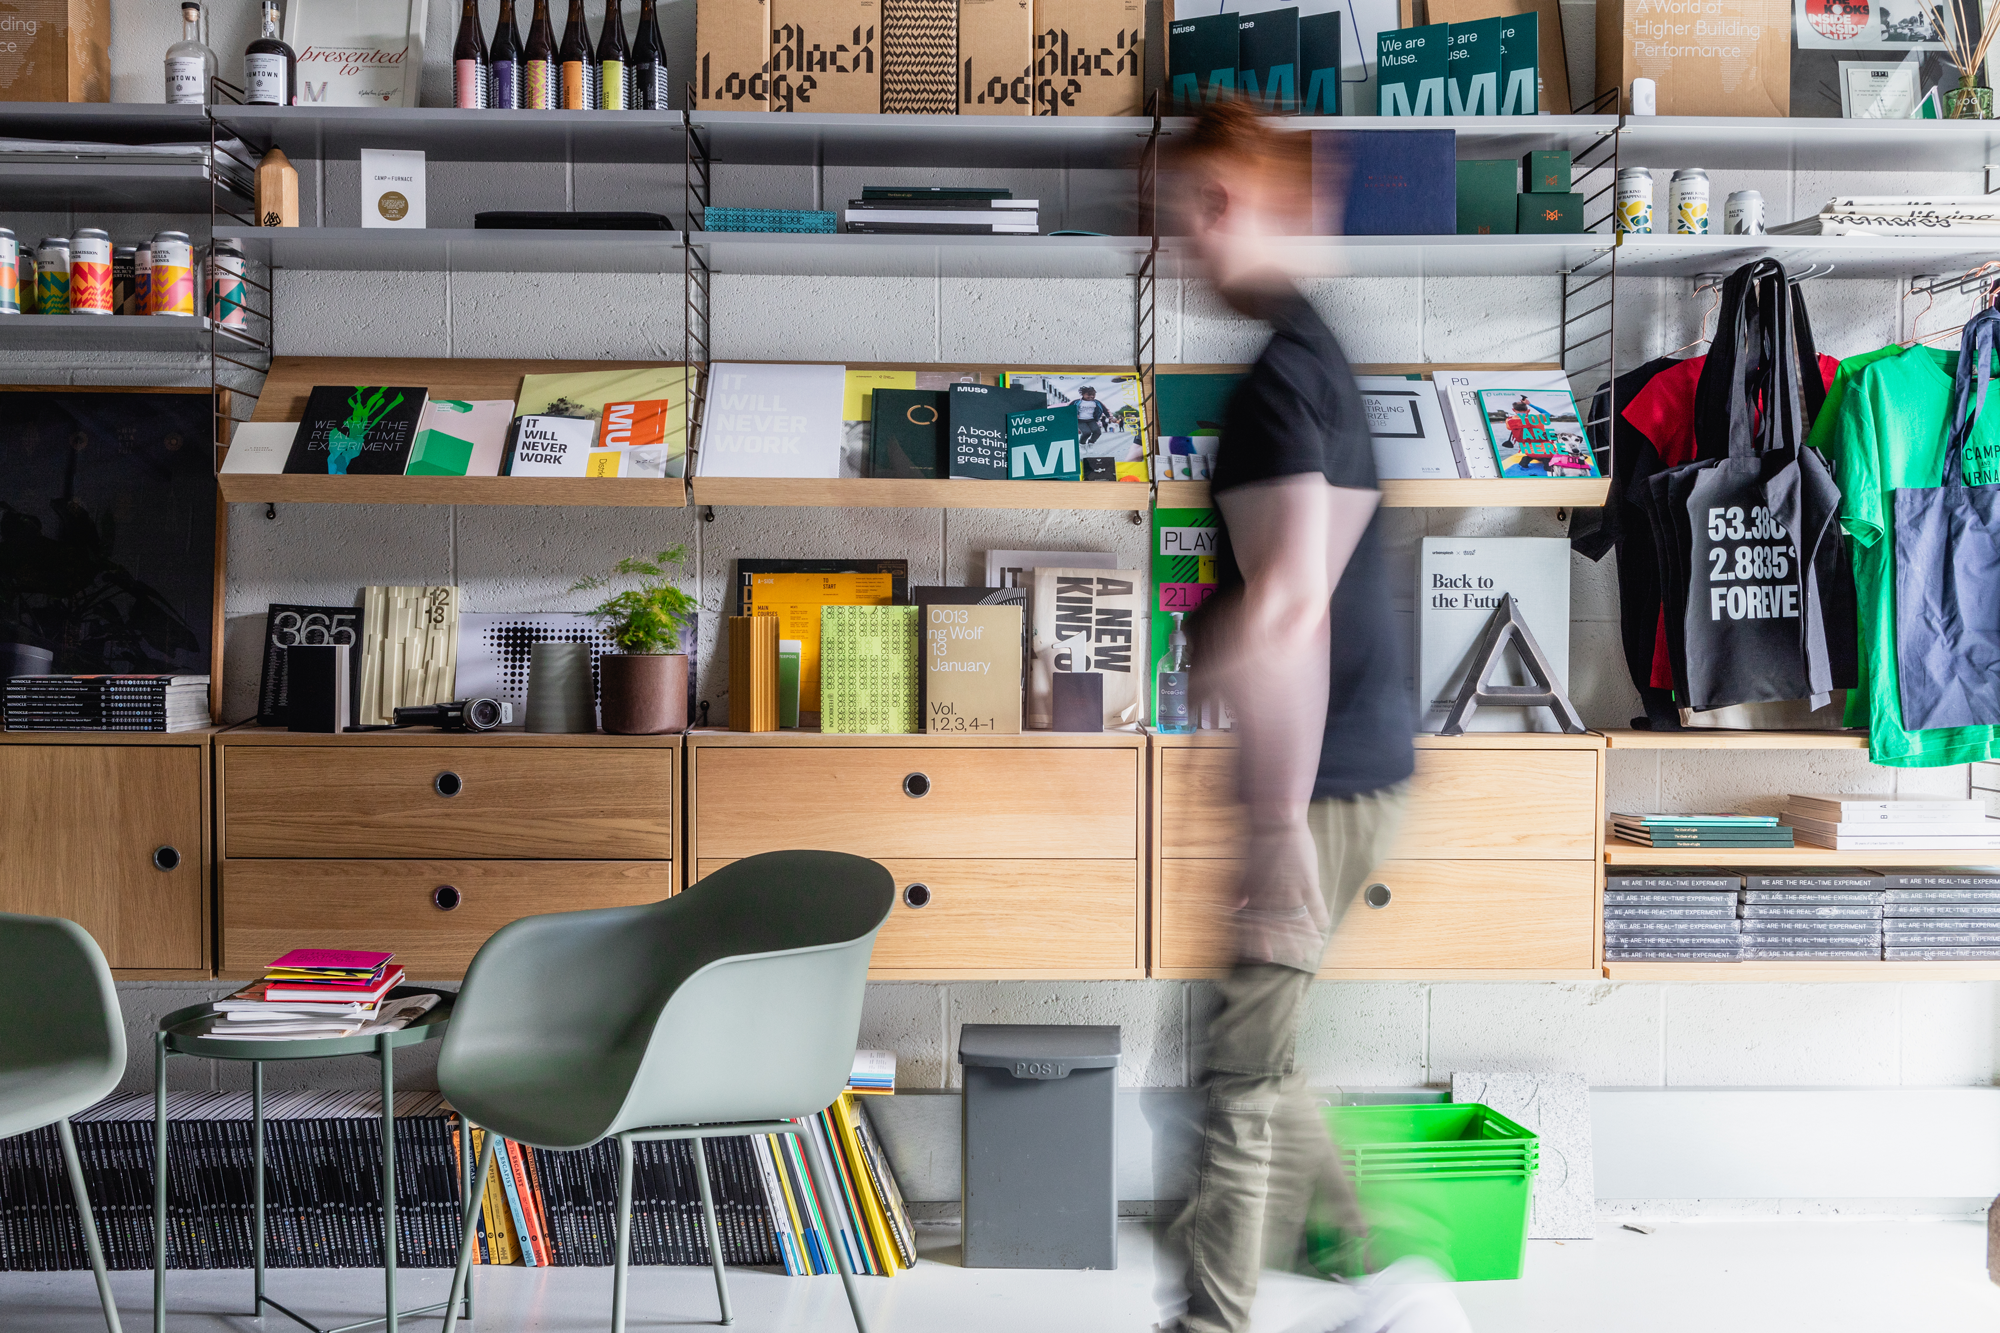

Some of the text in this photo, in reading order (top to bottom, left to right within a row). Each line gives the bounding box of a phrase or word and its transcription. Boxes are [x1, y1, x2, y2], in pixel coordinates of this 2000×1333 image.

[1636, 0, 1724, 13] A World of
[1240, 21, 1254, 30] use
[1635, 20, 1761, 40] Higher Building
[1381, 37, 1425, 52] We are
[1457, 32, 1477, 44] are
[297, 46, 408, 64] presented
[773, 23, 874, 73] Black
[1038, 28, 1138, 76] Black
[1635, 41, 1741, 57] Performance
[1381, 54, 1418, 67] Muse.
[339, 63, 364, 76] to
[721, 373, 747, 391] IT
[719, 393, 788, 412] WILL
[1120, 376, 1139, 436] PORT LOOP
[315, 420, 409, 430] WE ARE THE
[526, 418, 540, 428] IT
[716, 413, 808, 434] NEVER
[1011, 414, 1055, 426] We are
[1517, 413, 1551, 426] YOU
[524, 429, 558, 441] WILL
[957, 425, 1002, 438] A book
[1011, 425, 1048, 436] Muse.
[1522, 428, 1558, 441] ARE
[307, 441, 403, 451] EXPERIMENT
[714, 434, 801, 455] WORK
[957, 435, 979, 444] the
[521, 441, 568, 454] NEVER
[957, 444, 991, 456] do to
[1520, 442, 1569, 455] HERE
[519, 452, 563, 465] WORK
[957, 454, 990, 466] great
[1011, 439, 1077, 478] M
[1962, 470, 2000, 486] URNA
[1165, 531, 1217, 551] PLAY
[1432, 573, 1494, 588] Back to
[429, 588, 450, 606] 12
[1432, 593, 1519, 608] the Futue
[1710, 584, 1799, 621] FOREVE
[425, 606, 445, 623] 13
[931, 610, 968, 624] 0013
[1055, 576, 1094, 643] KIND
[271, 611, 356, 649] 365
[1094, 577, 1133, 673] A NEW
[929, 626, 984, 642] ng Wolf
[931, 643, 947, 656] 13
[930, 658, 991, 675] January
[1441, 592, 1587, 735] A
[930, 702, 957, 715] Vol.
[1015, 1062, 1065, 1076] POST
[499, 1156, 512, 1188] ESCAPIST
[511, 1154, 524, 1187] ESCAPIST
